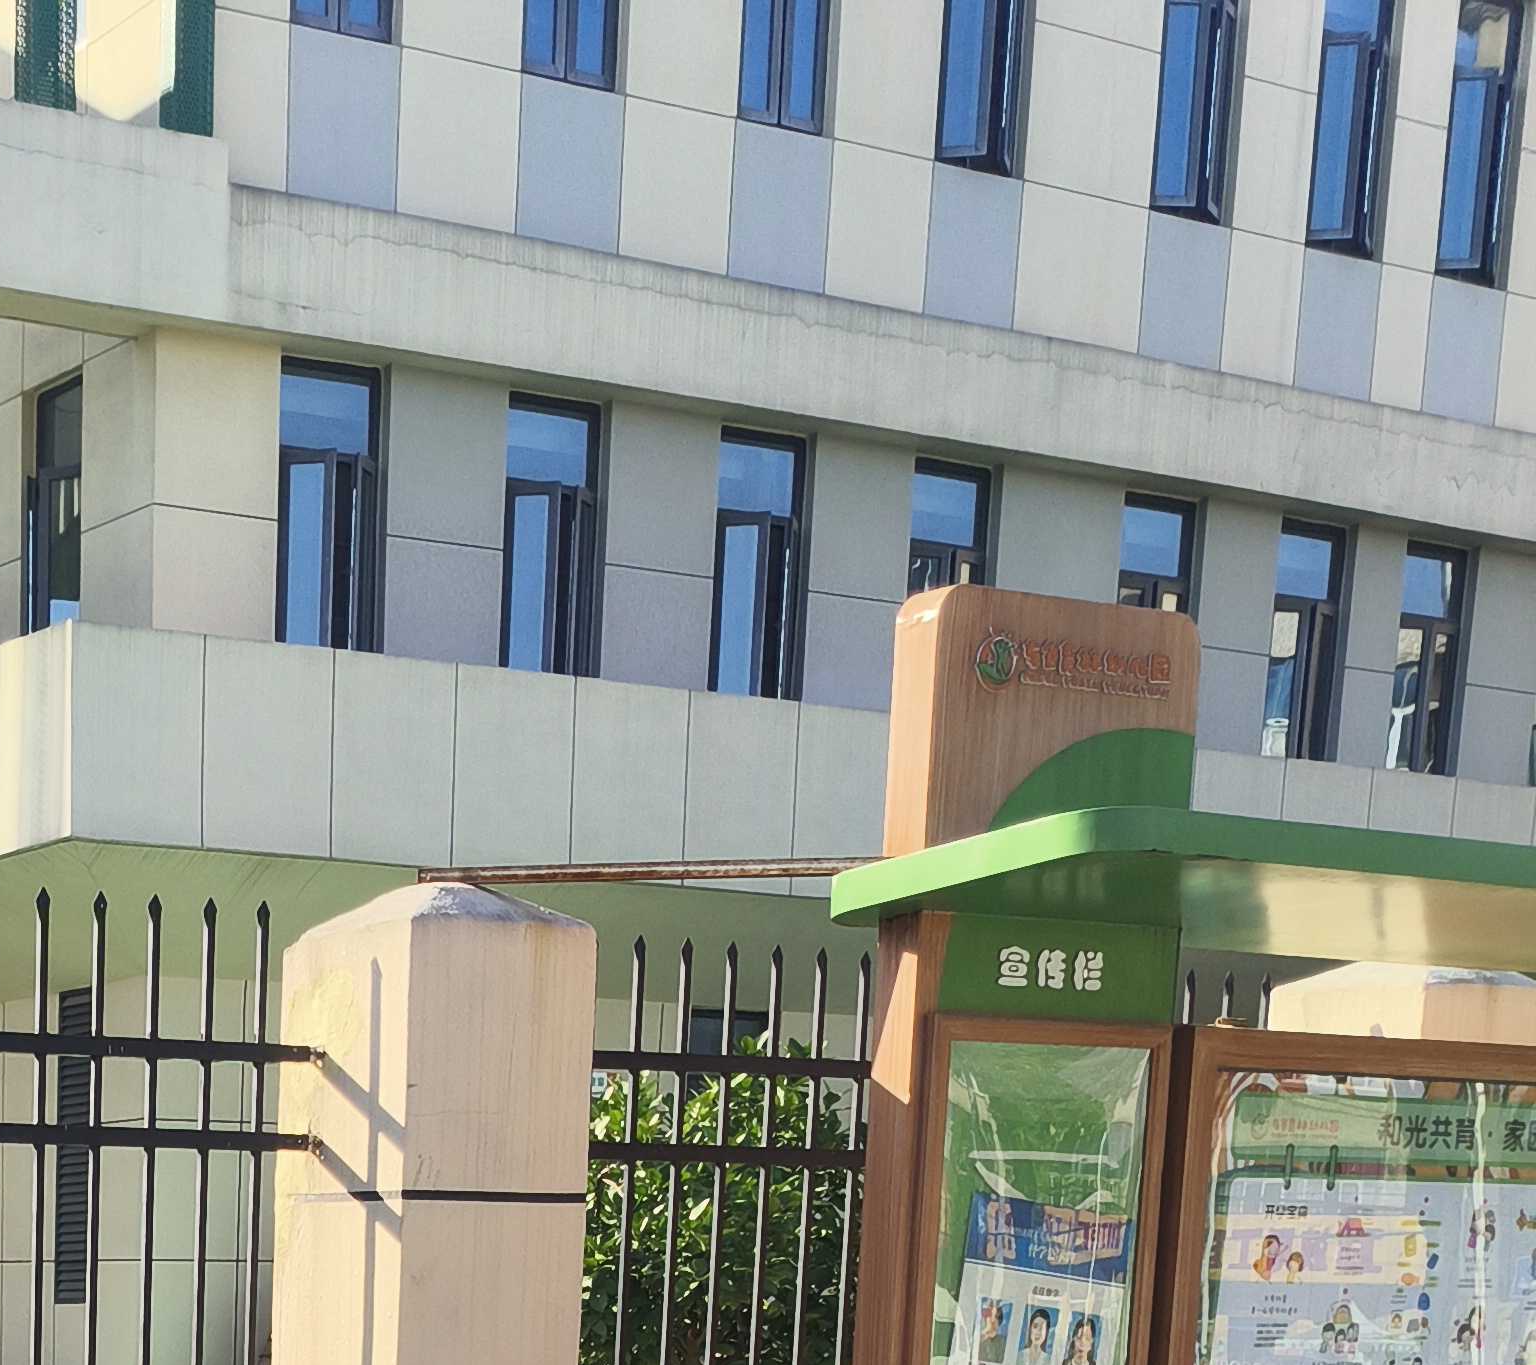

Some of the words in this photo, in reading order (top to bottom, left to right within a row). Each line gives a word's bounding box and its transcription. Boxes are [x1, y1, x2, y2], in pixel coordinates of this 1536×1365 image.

[997, 945, 1104, 991] 宣传栏
[1377, 1113, 1536, 1152] 和光共育·家
